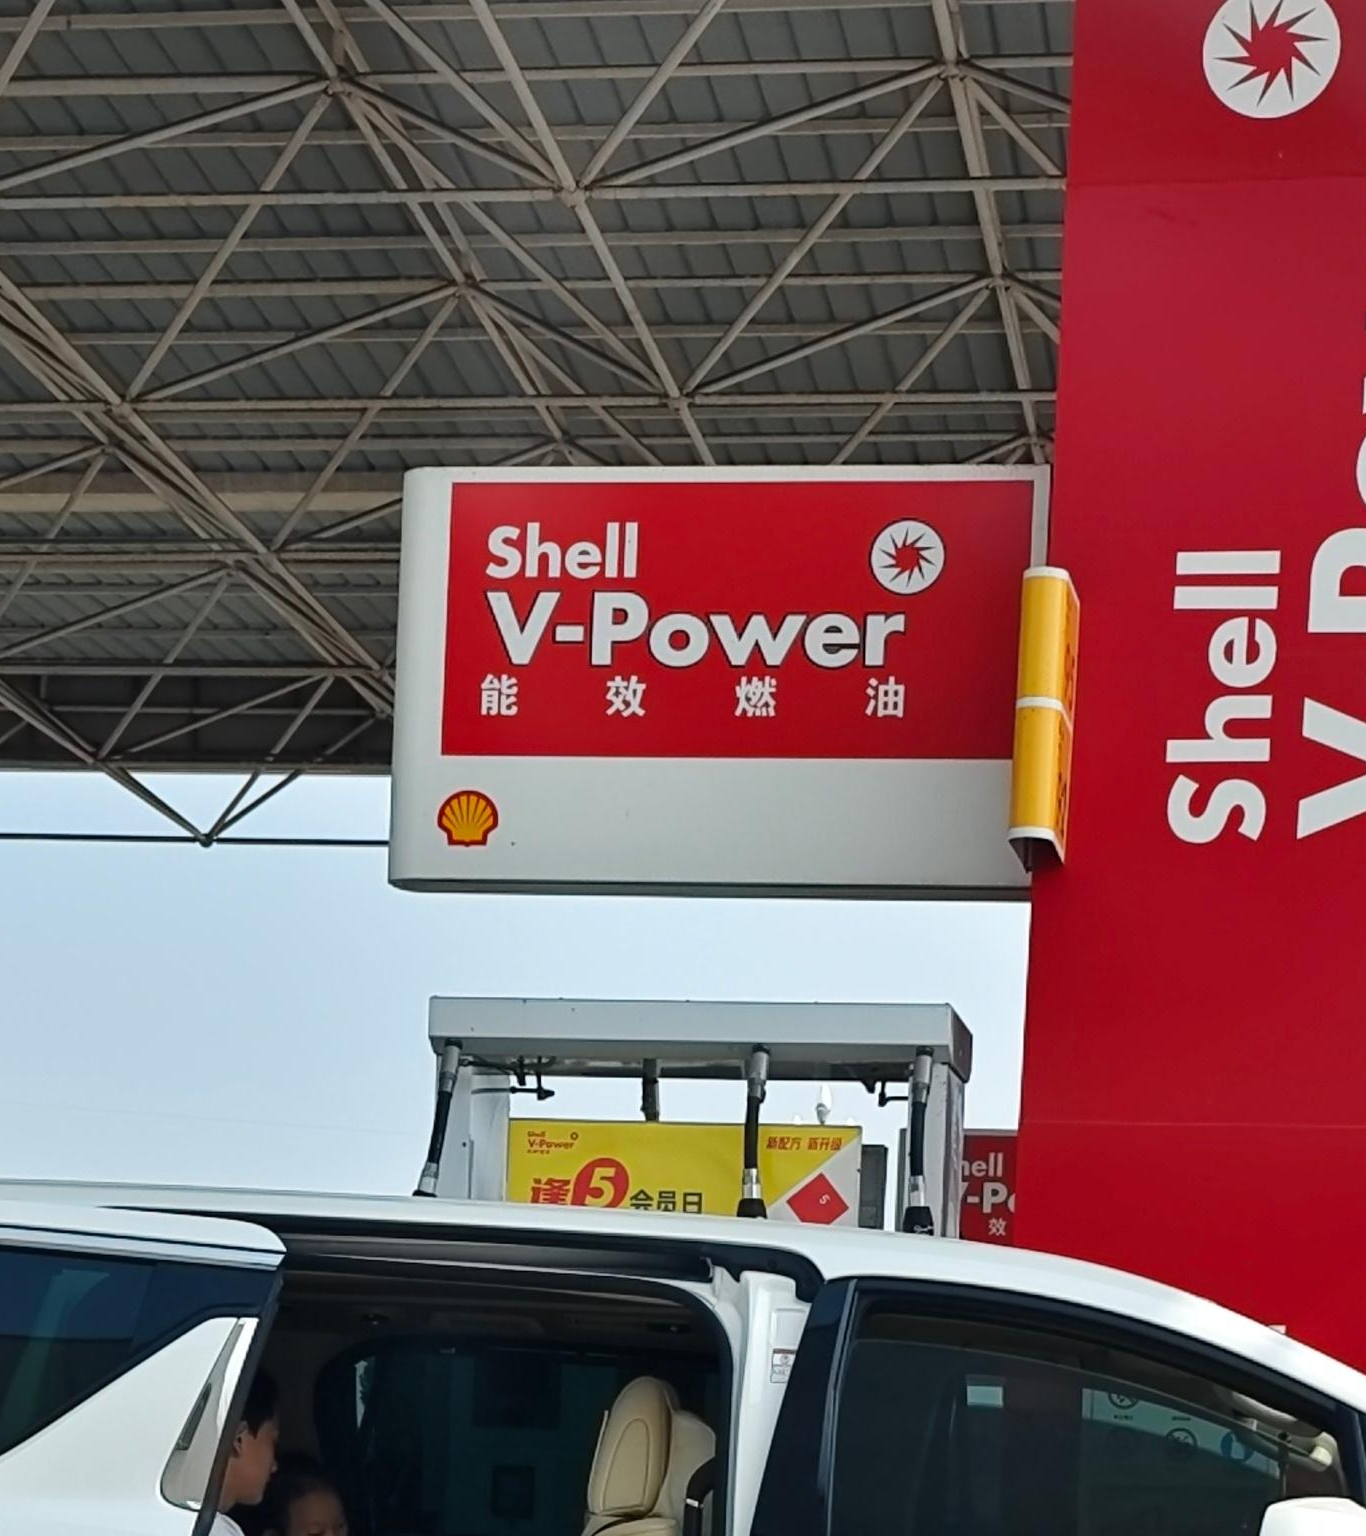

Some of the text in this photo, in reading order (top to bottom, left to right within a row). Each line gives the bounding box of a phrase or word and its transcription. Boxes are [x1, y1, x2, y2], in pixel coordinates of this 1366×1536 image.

[485, 521, 640, 579] Shell
[485, 590, 906, 669] V-Power
[479, 674, 906, 719] 能效燃油
[1165, 548, 1283, 844] Shell
